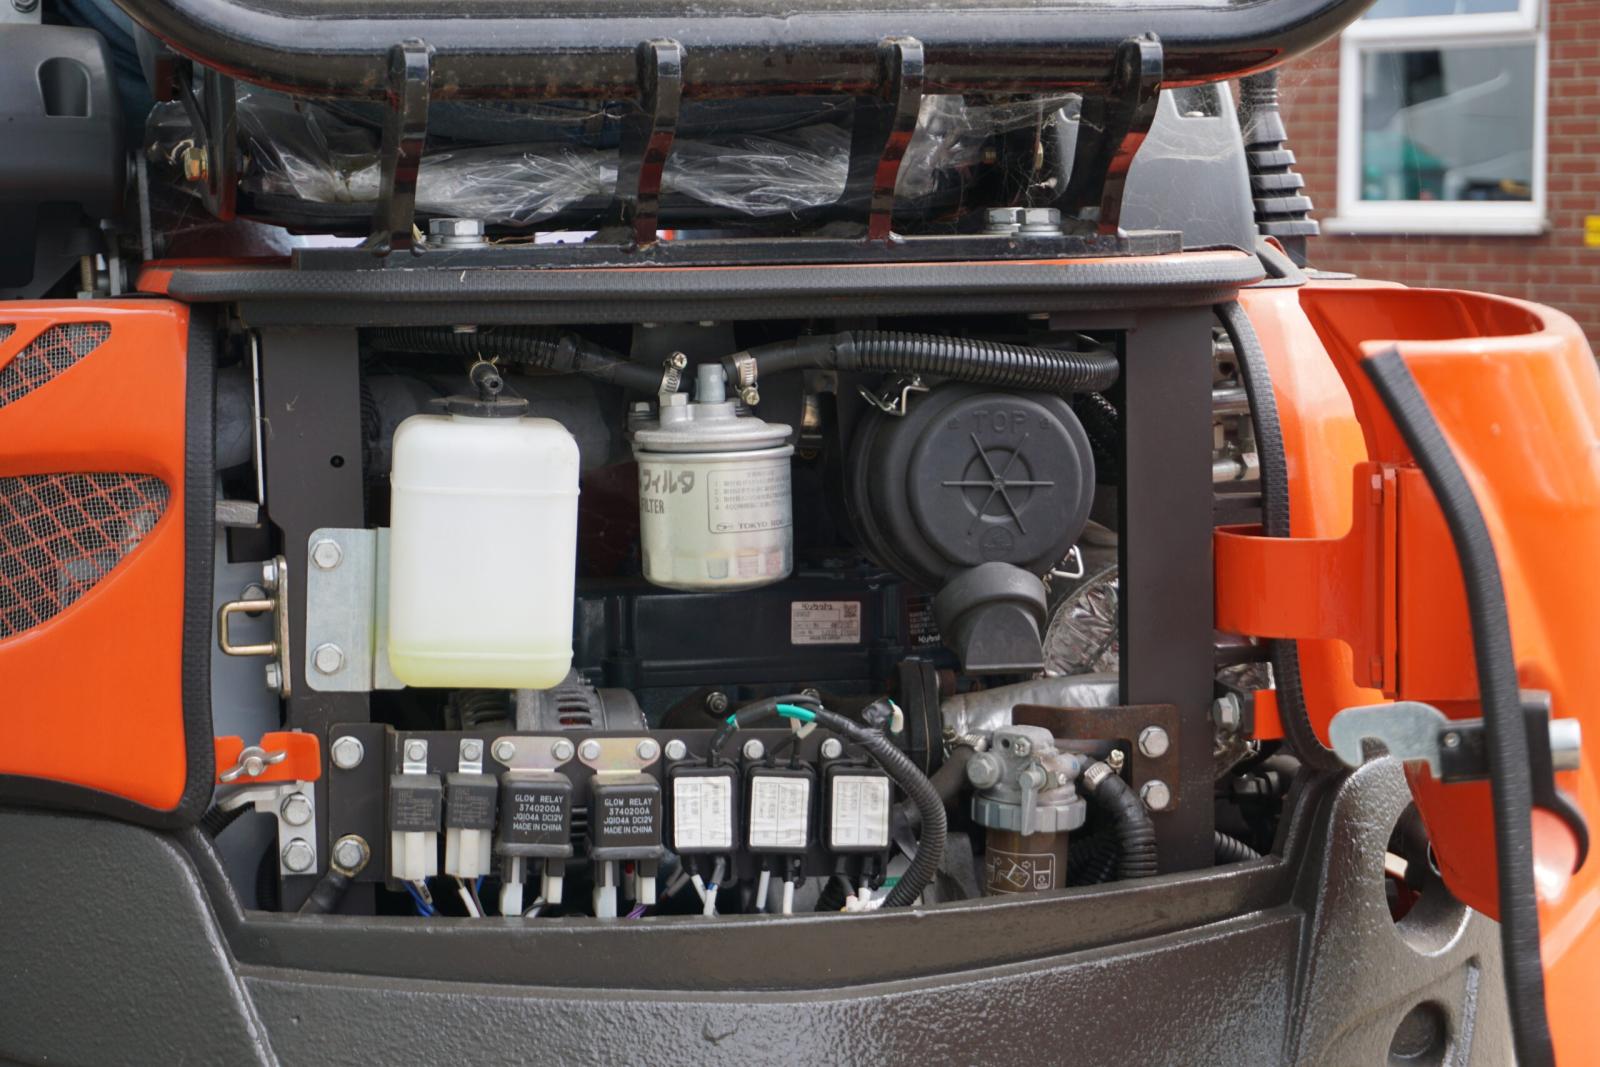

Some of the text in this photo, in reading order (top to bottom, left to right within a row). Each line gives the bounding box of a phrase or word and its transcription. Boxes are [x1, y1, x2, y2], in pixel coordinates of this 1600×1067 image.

[973, 410, 1026, 434] TOP
[640, 497, 665, 514] FILTER
[515, 794, 564, 803] GLOW RELAY
[604, 798, 653, 807] GLOW RELAY
[519, 804, 561, 813] 3740200A
[609, 807, 650, 816] 3740200A
[542, 813, 563, 822] DC12V
[632, 815, 653, 824] DC12V
[513, 822, 562, 832] MADE IN CHINA
[603, 825, 653, 835] MADE IN CHINA
